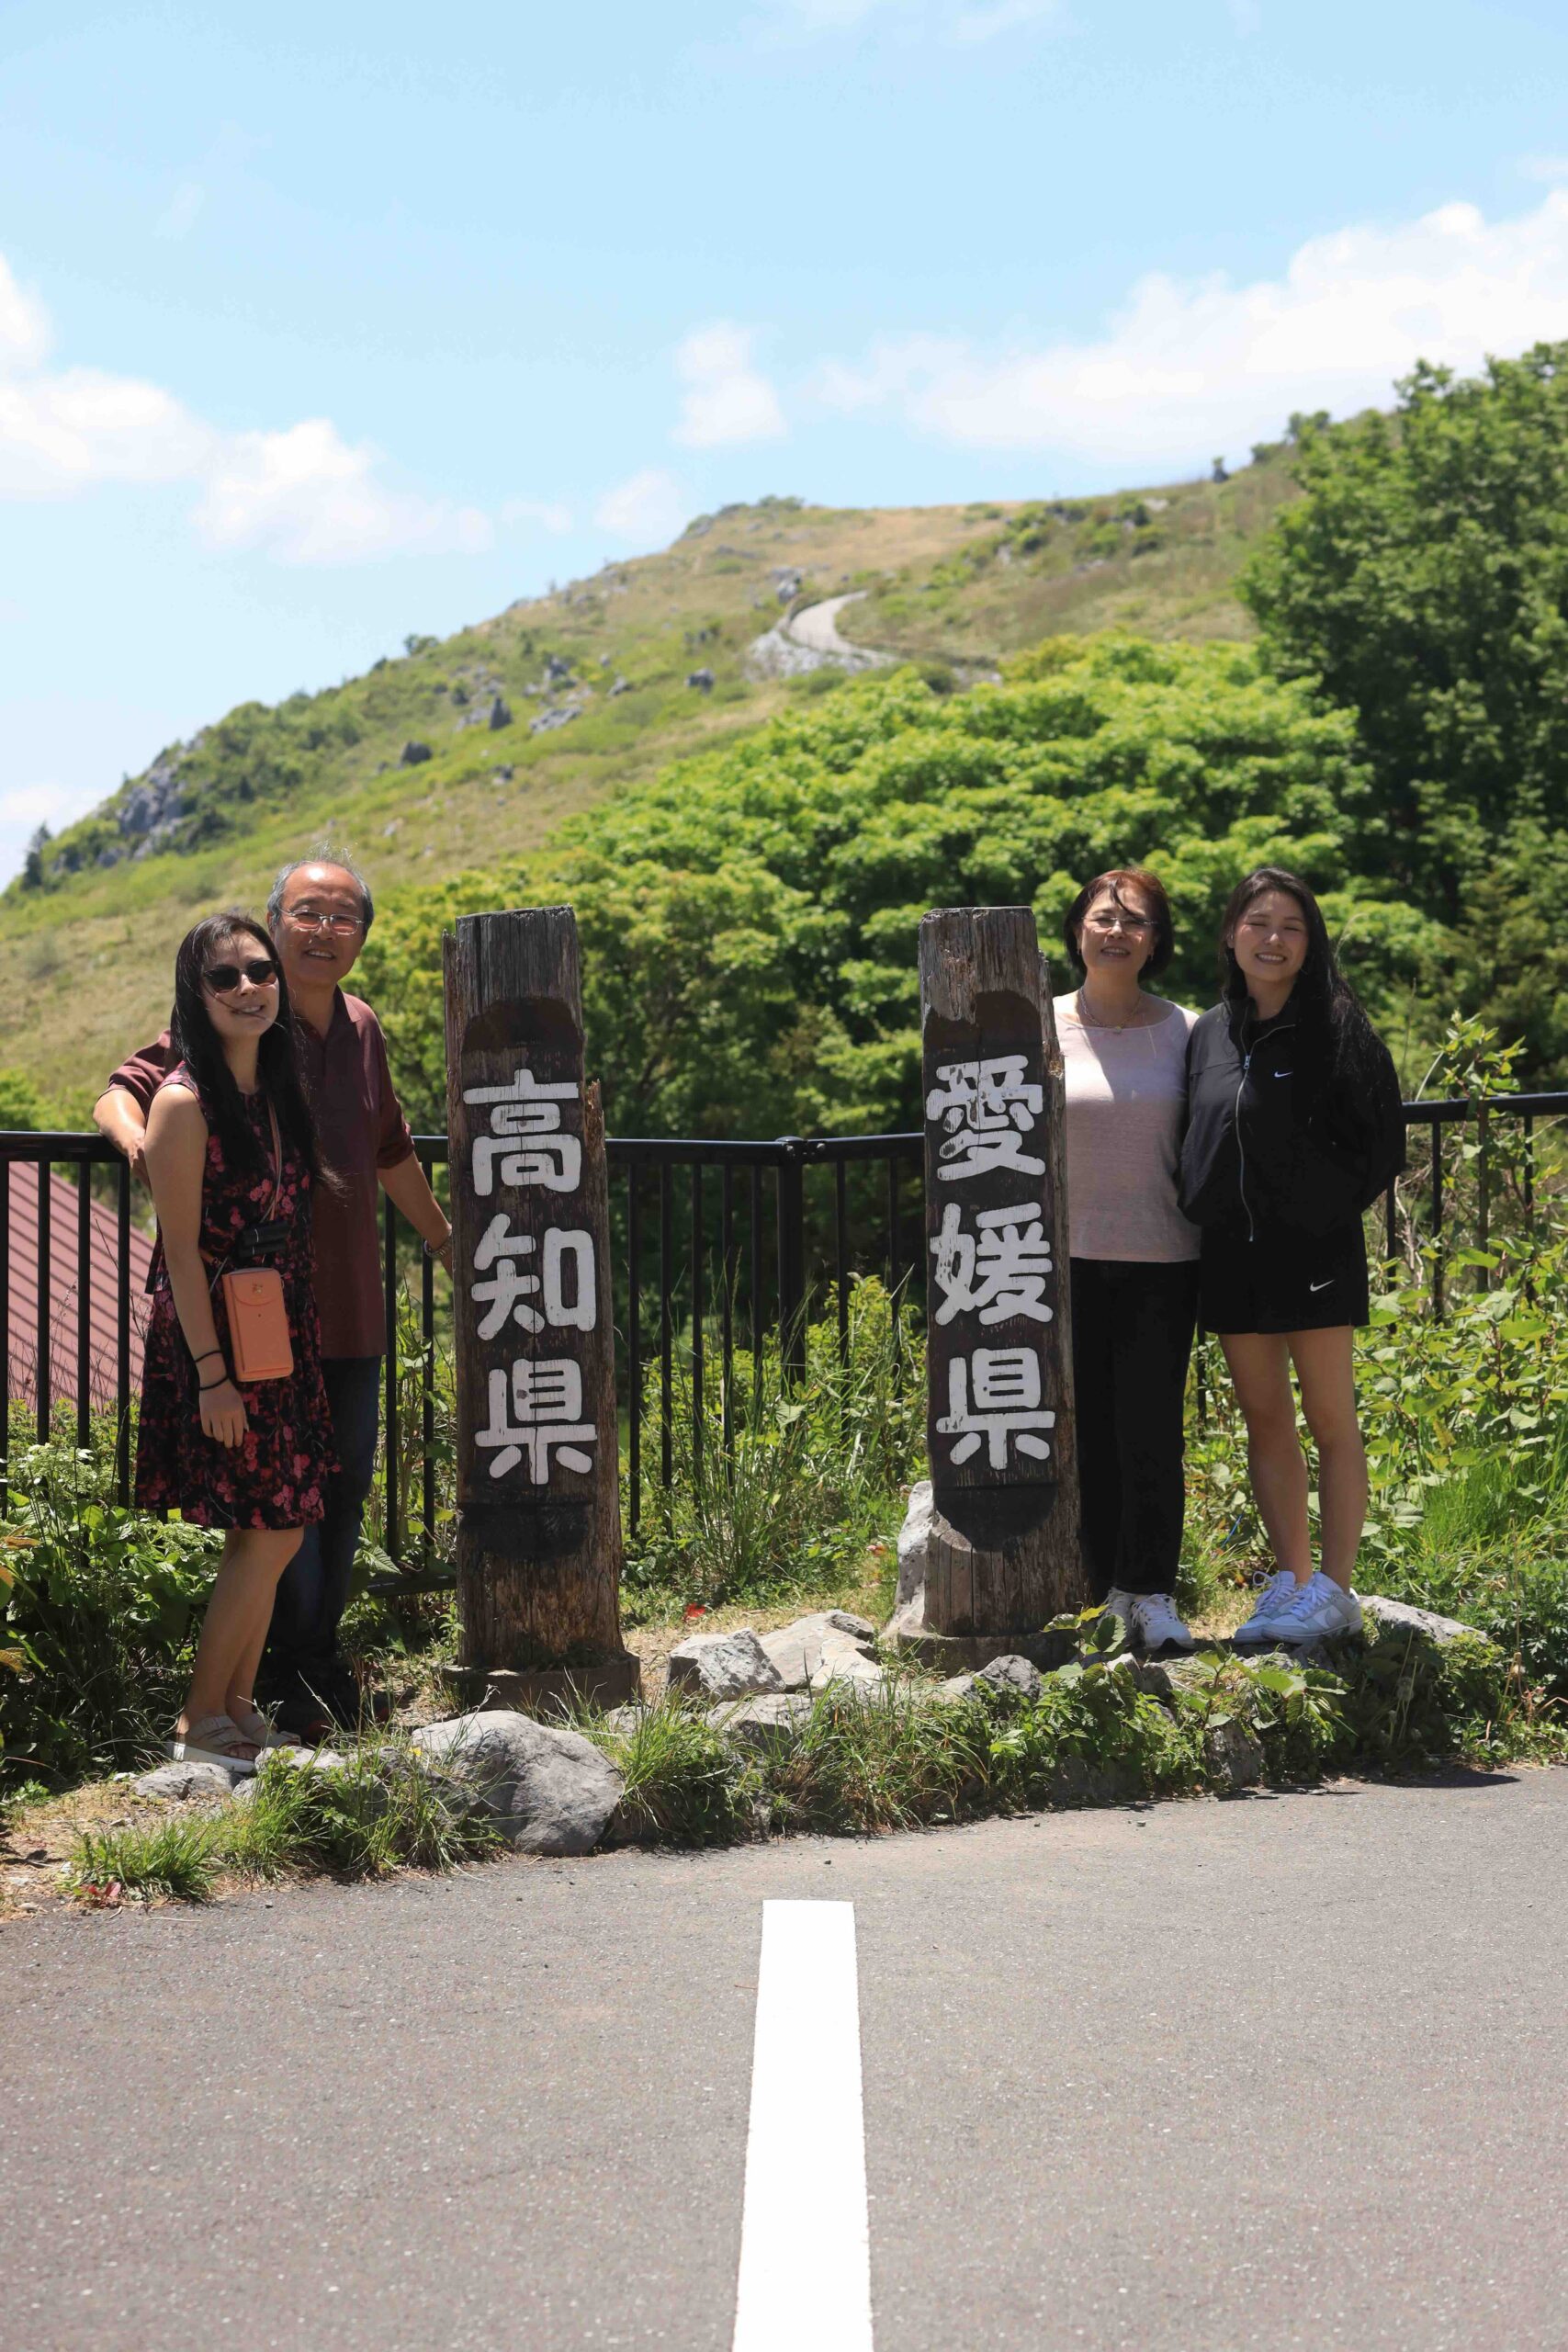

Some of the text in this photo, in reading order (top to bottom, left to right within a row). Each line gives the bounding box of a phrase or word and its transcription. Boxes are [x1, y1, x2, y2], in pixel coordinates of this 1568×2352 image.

[464, 1069, 597, 1485] 高知県
[927, 1055, 1055, 1470] 愛媛県
